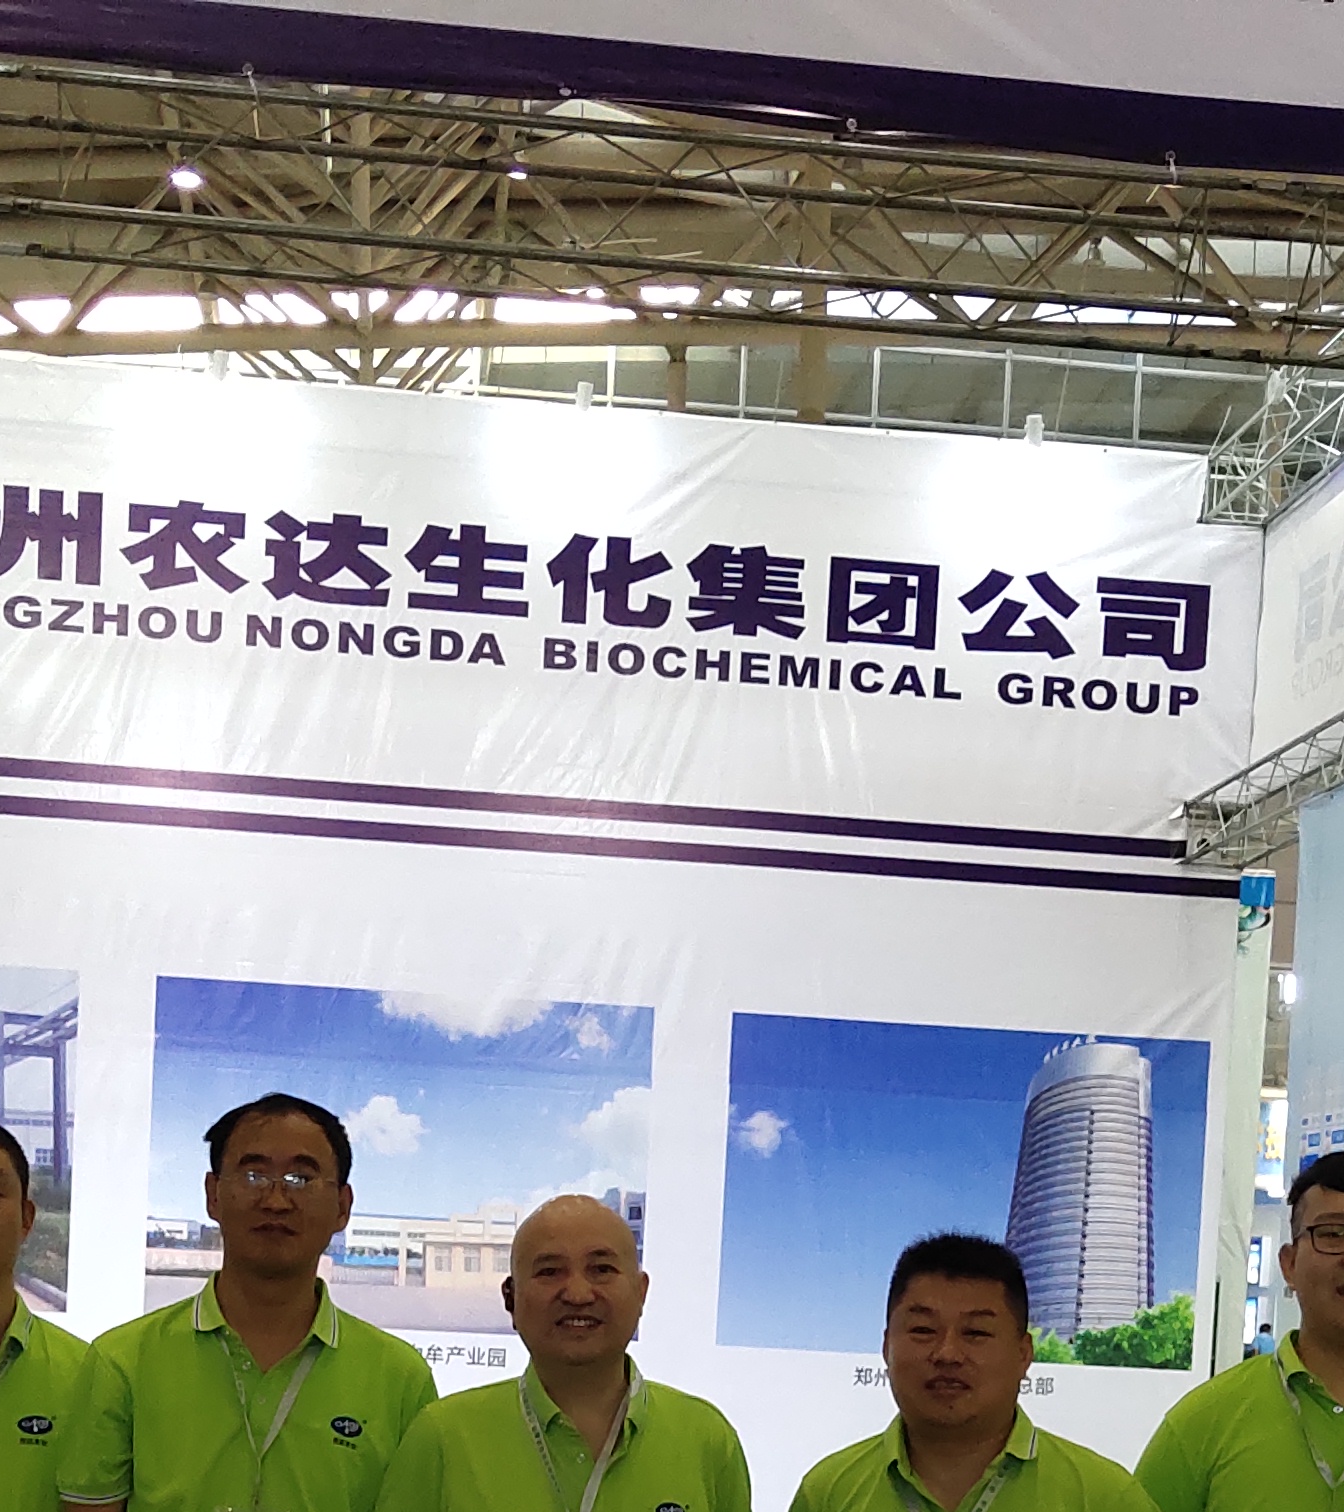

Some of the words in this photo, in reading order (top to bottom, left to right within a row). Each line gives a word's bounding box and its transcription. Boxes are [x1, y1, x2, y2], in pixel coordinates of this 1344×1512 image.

[246, 614, 507, 667] NONGDA
[544, 637, 962, 701] BIOCHEMICAL
[997, 673, 1200, 717] GROUP
